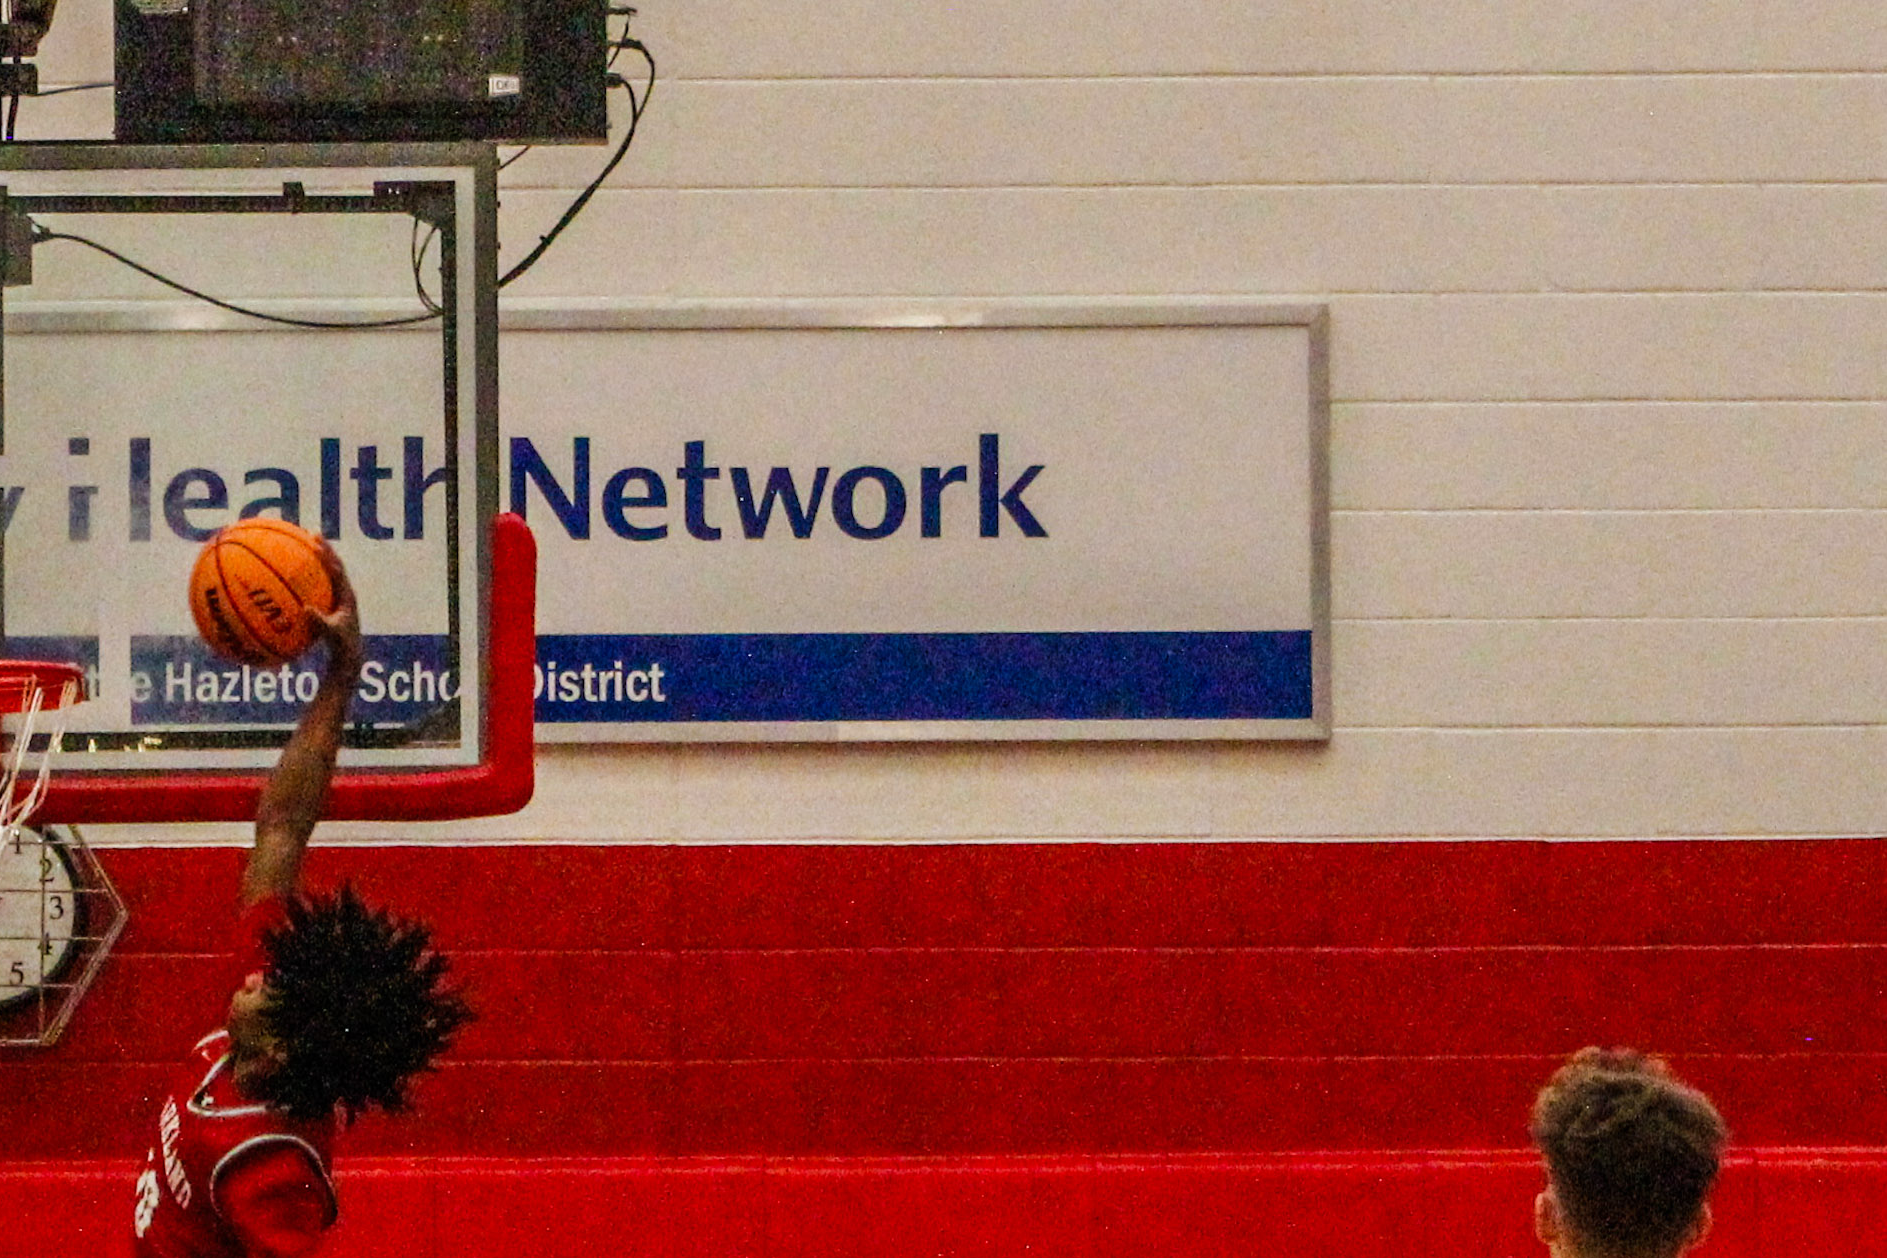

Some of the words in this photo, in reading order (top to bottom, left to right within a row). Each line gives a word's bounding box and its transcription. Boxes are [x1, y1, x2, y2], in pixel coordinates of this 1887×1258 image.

[509, 433, 1049, 541] Network
[84, 663, 153, 703] te
[166, 662, 319, 703] Hazleto
[358, 660, 460, 702] Scho
[39, 858, 54, 883] 2
[49, 895, 64, 920] 3
[38, 932, 53, 956] 4
[9, 961, 24, 986] 5
